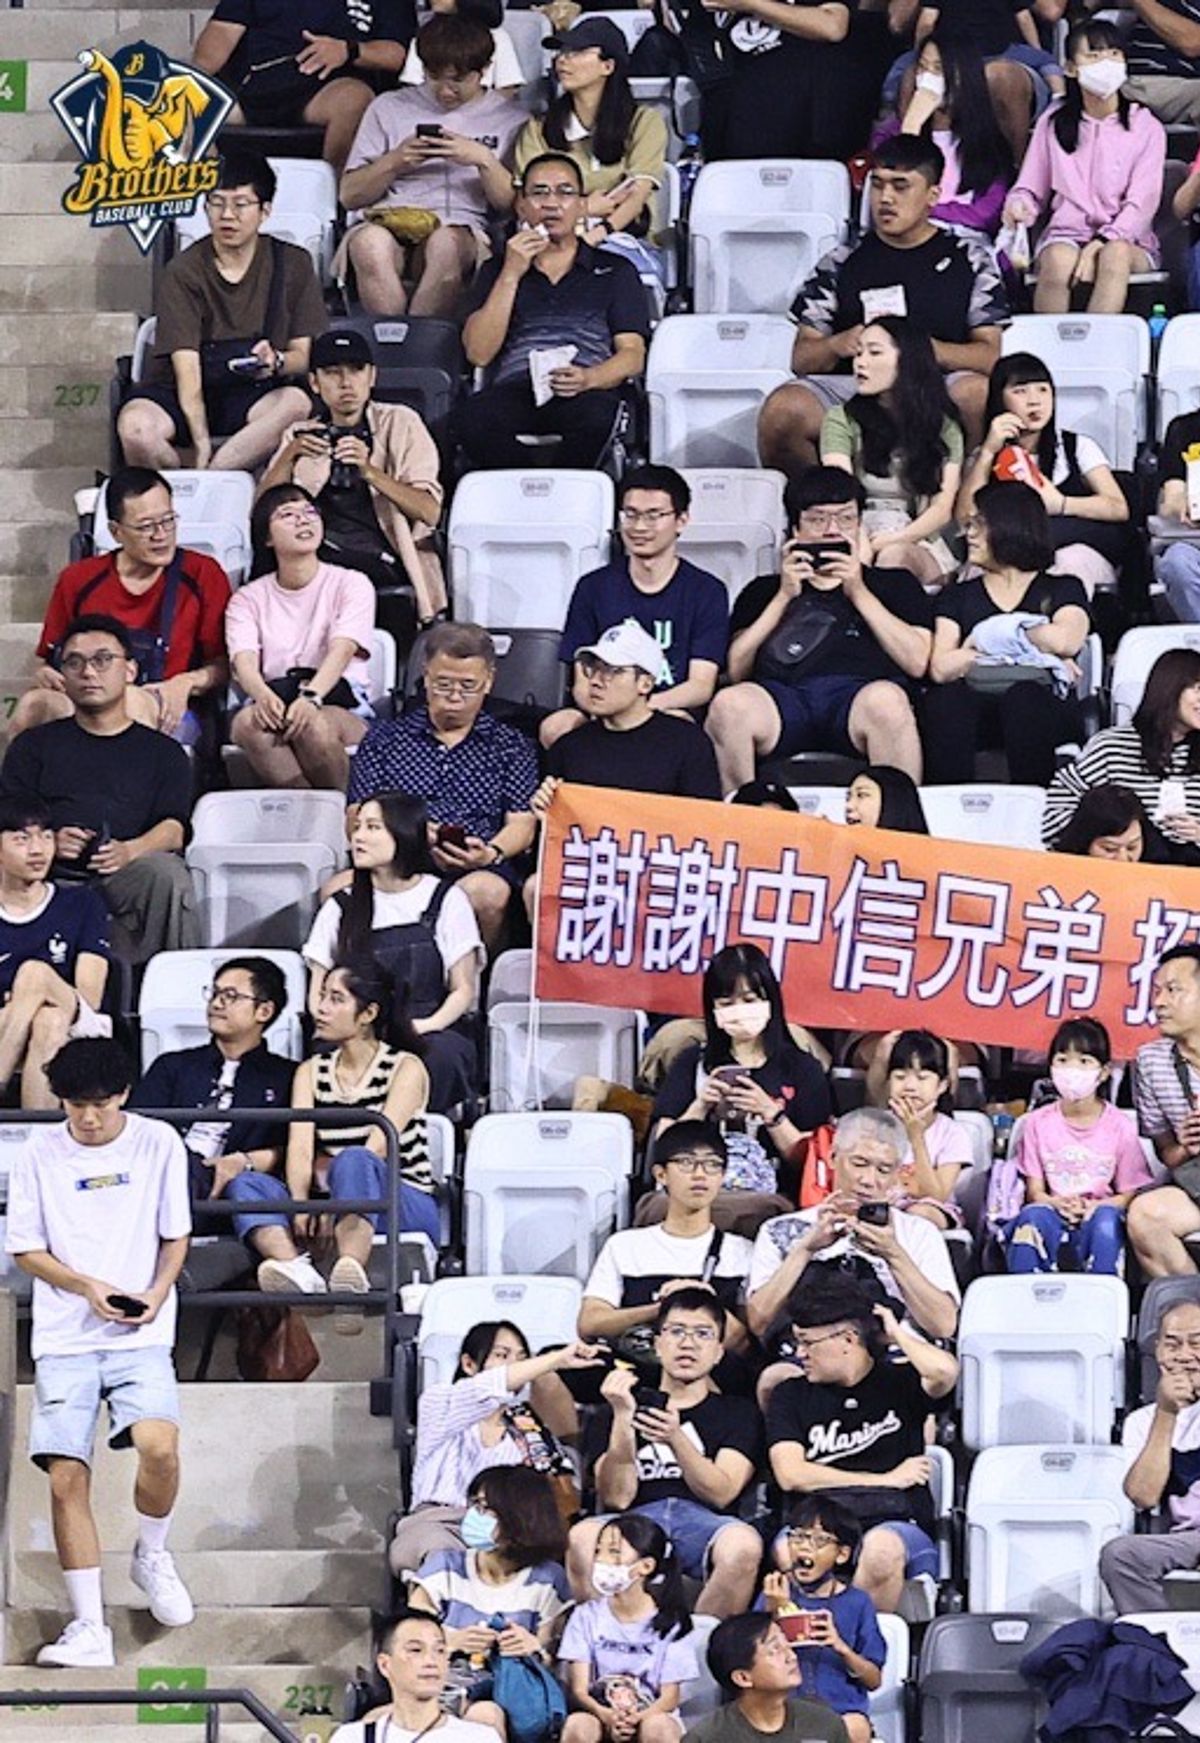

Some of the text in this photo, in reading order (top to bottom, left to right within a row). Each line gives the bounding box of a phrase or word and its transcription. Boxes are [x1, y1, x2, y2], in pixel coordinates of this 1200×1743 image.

[54, 384, 101, 407] 237
[555, 822, 1106, 1018] 謝謝中信兄弟
